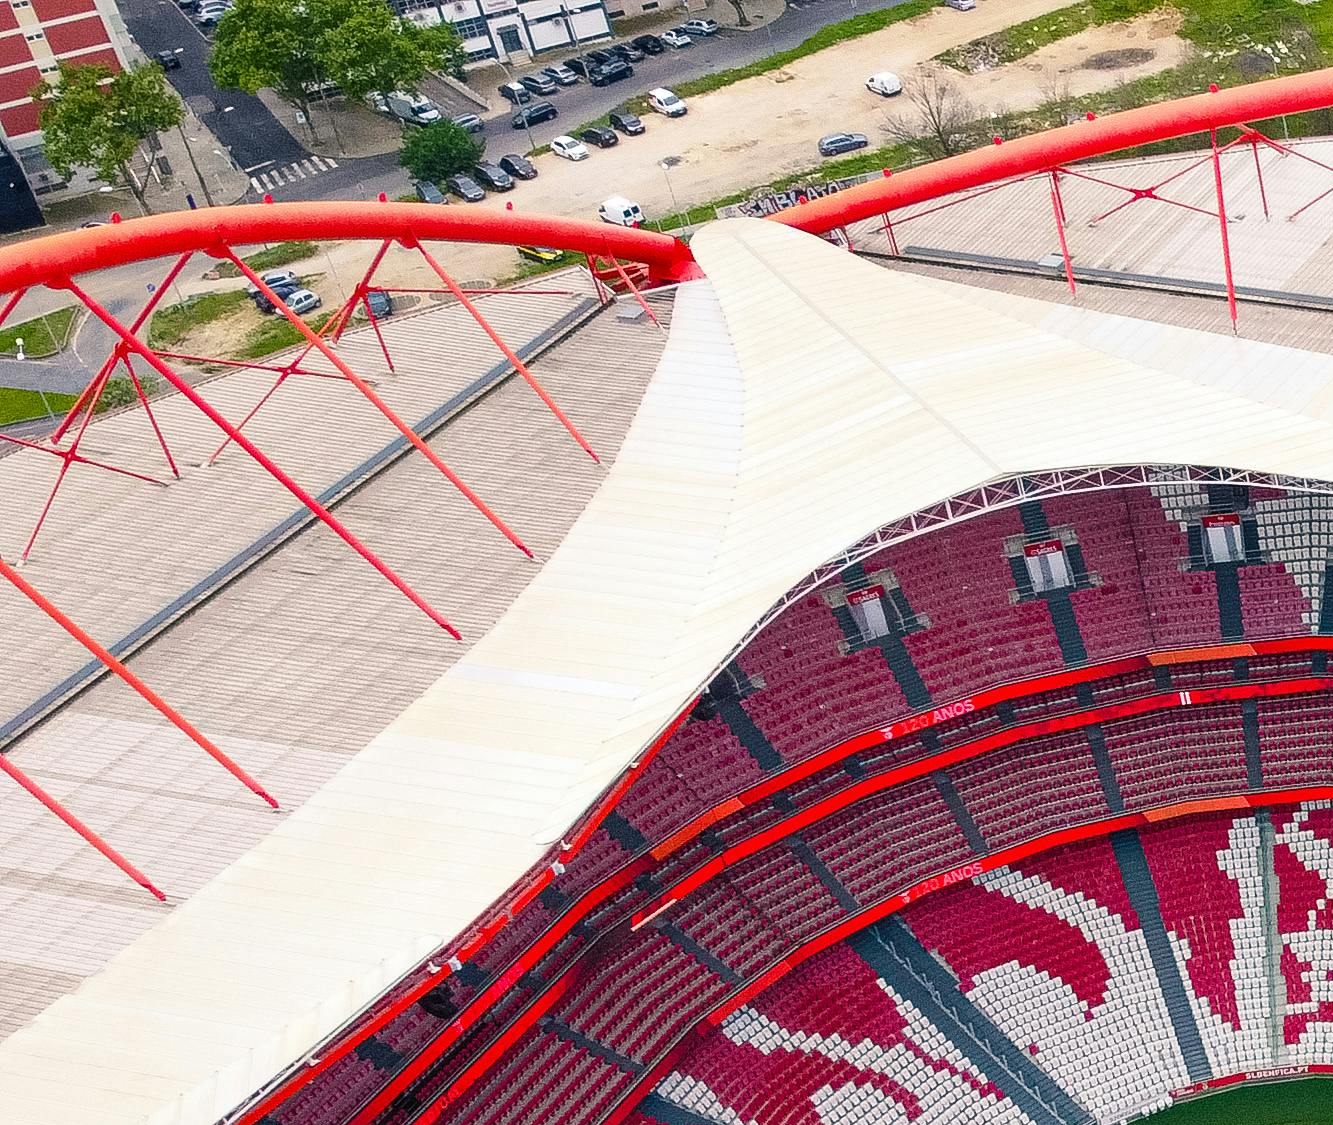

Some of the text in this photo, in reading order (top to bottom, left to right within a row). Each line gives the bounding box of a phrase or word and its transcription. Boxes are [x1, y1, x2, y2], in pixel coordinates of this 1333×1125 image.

[902, 699, 975, 734] 120 ANOS
[943, 863, 983, 886] ANOS
